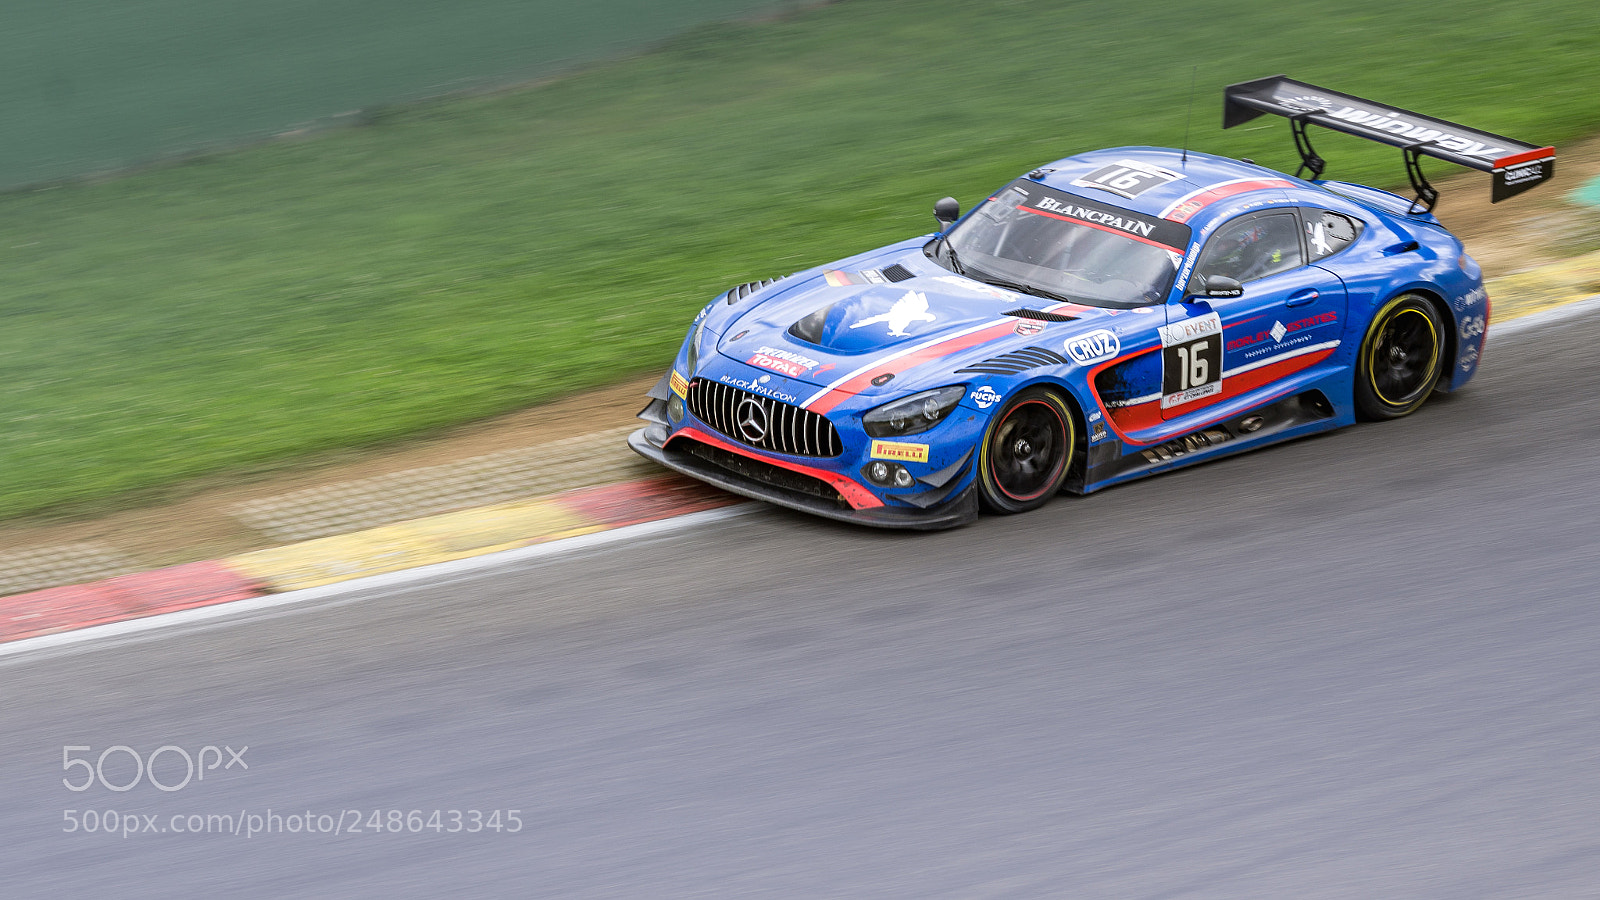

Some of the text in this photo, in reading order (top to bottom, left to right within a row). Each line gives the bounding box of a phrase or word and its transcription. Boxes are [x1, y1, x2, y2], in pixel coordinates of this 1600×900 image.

[1328, 106, 1506, 156] winway
[1095, 167, 1155, 189] 16
[1036, 196, 1156, 237] BLANCPAIN
[1226, 311, 1337, 351] MORLEY ESTATES
[1069, 333, 1115, 361] CRUZ
[752, 353, 799, 377] TOTAL
[1177, 341, 1209, 390] 16
[720, 375, 797, 403] BLACK FALCON
[970, 391, 1002, 403] FUCHS
[876, 443, 924, 459] PIRELLI
